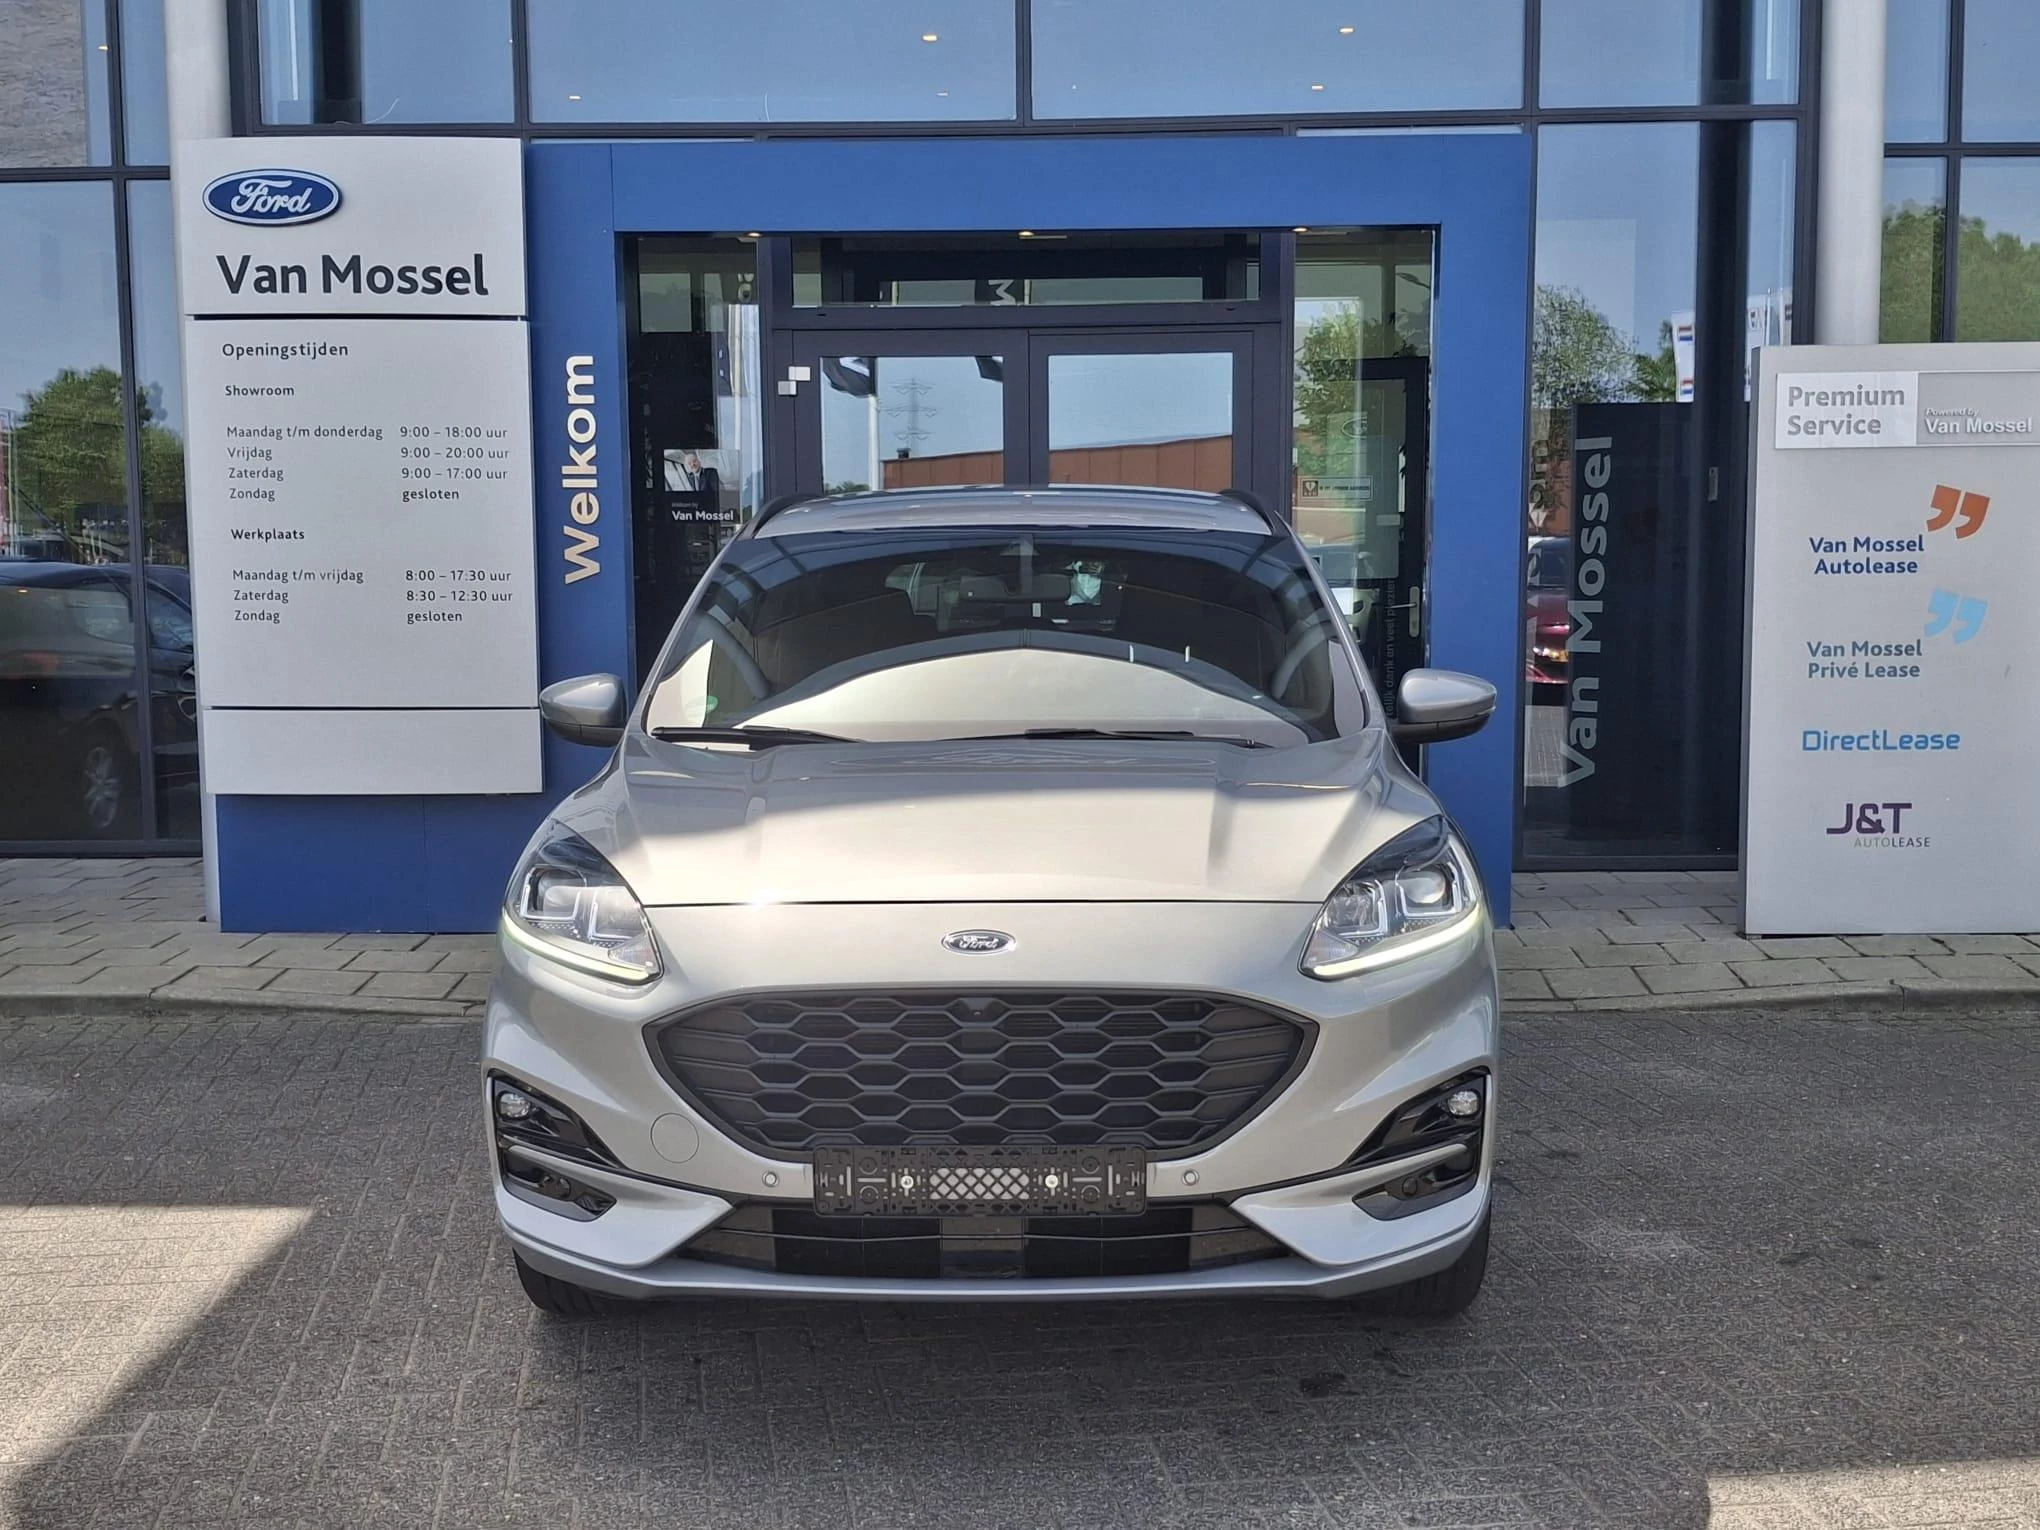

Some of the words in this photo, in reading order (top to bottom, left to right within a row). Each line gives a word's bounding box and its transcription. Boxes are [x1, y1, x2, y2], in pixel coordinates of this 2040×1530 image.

[231, 178, 313, 214] Ford
[216, 255, 307, 294] Van
[322, 254, 488, 295] Mossel
[223, 342, 348, 360] Openingstijden
[226, 385, 294, 395] Showroom
[1788, 384, 1905, 407] Premium
[1787, 414, 1881, 435] Service
[1925, 418, 1960, 433] Van
[1966, 416, 2033, 433] Mossel
[227, 426, 283, 440] Maandag
[287, 426, 309, 437] t/m
[314, 426, 382, 440] donderdag
[400, 426, 429, 437] 9:00
[446, 427, 481, 437] 18:00
[487, 430, 507, 438] uur
[228, 447, 272, 461] Vrijdag
[401, 447, 430, 458] 9:00
[446, 447, 483, 458] 20:00
[229, 468, 283, 481] Zaterdag
[402, 468, 431, 478] 9:00
[447, 468, 481, 479] 17:00
[487, 471, 507, 479] uur
[562, 355, 600, 585] Welkom
[230, 488, 275, 502] Zondag
[403, 488, 459, 502] gesloten
[671, 510, 693, 521] Van
[695, 509, 734, 521] Mossel
[231, 528, 304, 543] Werkplaats
[1566, 436, 1613, 653] Mossel
[1809, 537, 1846, 553] Van
[1854, 534, 1924, 552] Mossel
[1815, 557, 1917, 574] Autolease
[233, 570, 288, 583] Maandag
[293, 570, 315, 580] t/m
[320, 570, 363, 584] vrijdag
[406, 570, 434, 580] 8:00
[451, 570, 485, 581] 17:30
[490, 573, 511, 581] uur
[234, 590, 288, 604] Zaterdag
[407, 591, 435, 601] 8:30
[451, 591, 486, 601] 12:30
[235, 610, 280, 624] Zondag
[408, 611, 462, 624] gesloten
[1807, 641, 1844, 657] Van
[1852, 639, 1922, 656] Mossel
[1809, 662, 1858, 678] Privé
[1865, 662, 1920, 677] Lease
[1557, 676, 1600, 788] Van
[1802, 730, 1960, 751] DirectLease
[1826, 803, 1912, 834] J&T
[1854, 837, 1930, 848] AUTOLEASE
[958, 935, 999, 949] Ford
